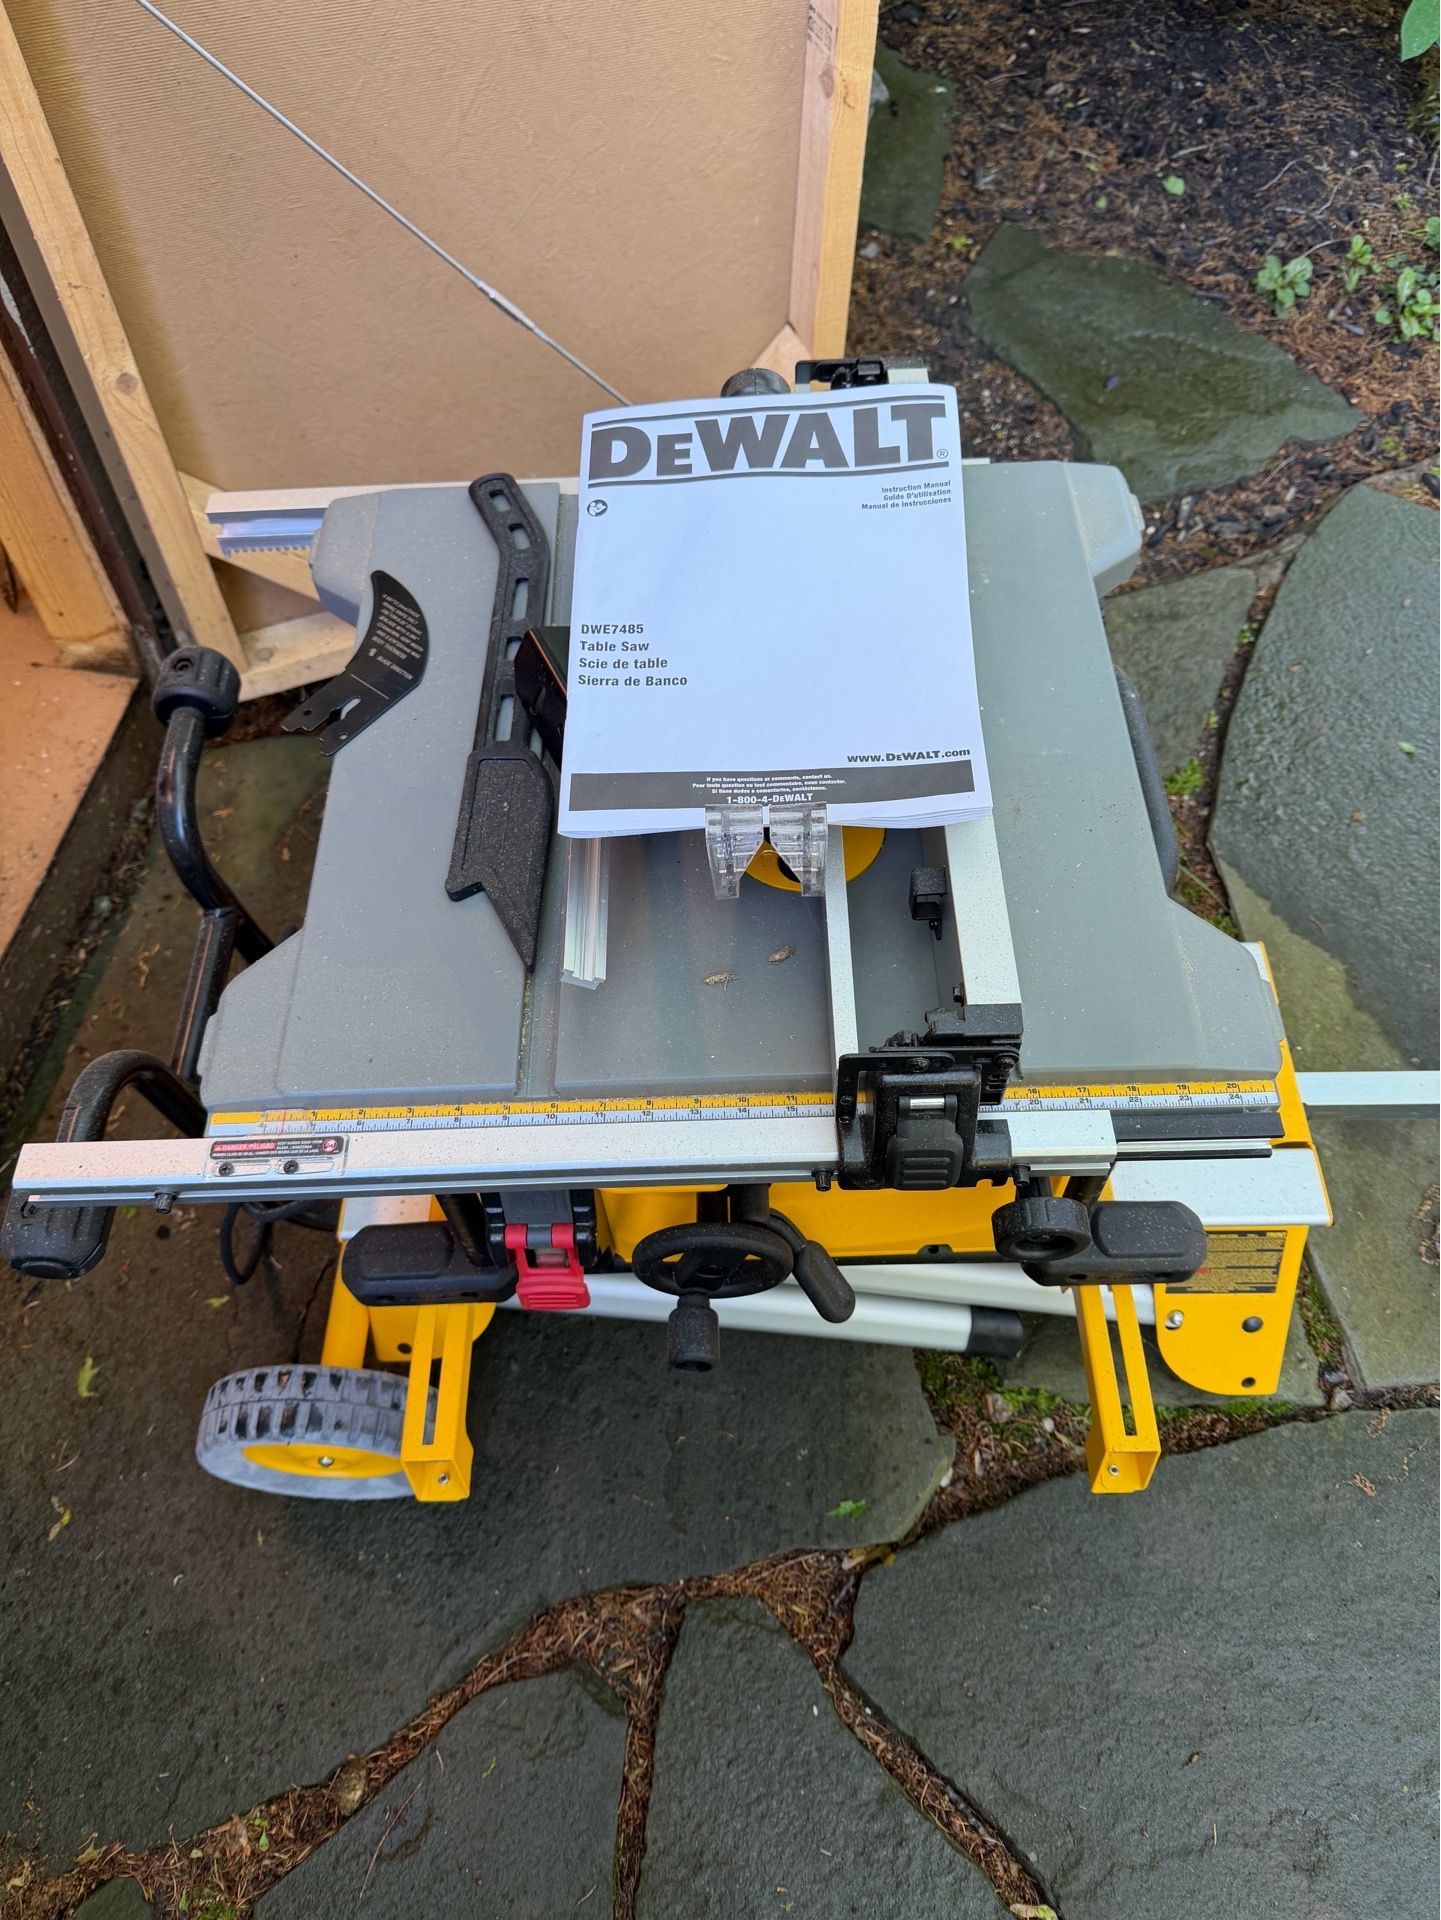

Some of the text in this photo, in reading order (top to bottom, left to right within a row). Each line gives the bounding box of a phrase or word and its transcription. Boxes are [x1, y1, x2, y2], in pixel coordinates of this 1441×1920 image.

[588, 402, 946, 481] DEWALT
[882, 480, 951, 493] Instruction Manual
[884, 488, 952, 501] Guide D'utilisation
[581, 624, 644, 634] DWE7485
[580, 641, 650, 652] Table Saw
[579, 658, 668, 669] Scie de table
[578, 674, 688, 686] Sierra de Banco
